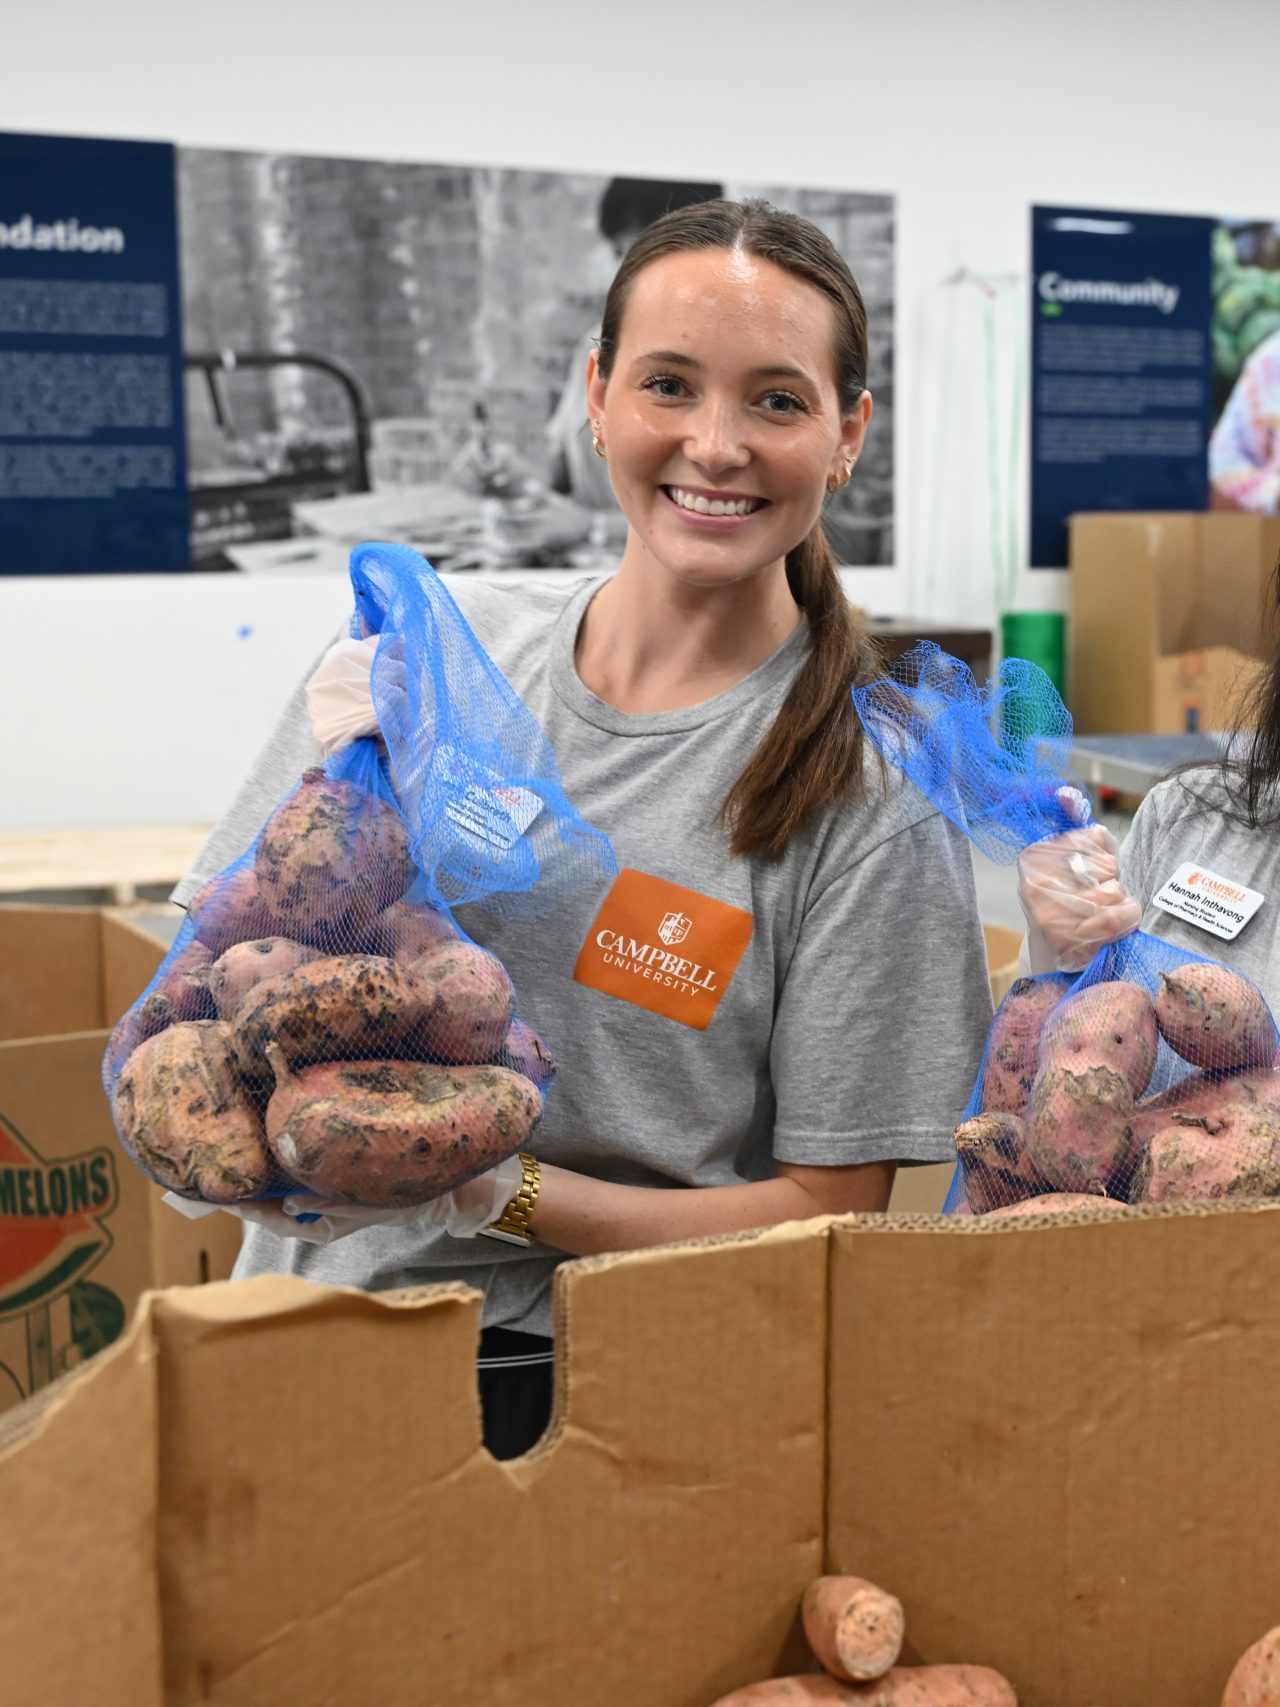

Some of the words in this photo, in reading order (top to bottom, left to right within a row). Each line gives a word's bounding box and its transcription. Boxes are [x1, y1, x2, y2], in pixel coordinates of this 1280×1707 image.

[1038, 271, 1180, 315] Community
[1168, 881, 1201, 902] Hannah
[1201, 896, 1245, 924] Inthavong
[1200, 876, 1246, 902] CAMPBELL
[596, 929, 717, 991] CAMPBELL
[603, 952, 699, 997] UNIVERSITY
[0, 1155, 109, 1217] MELONS
